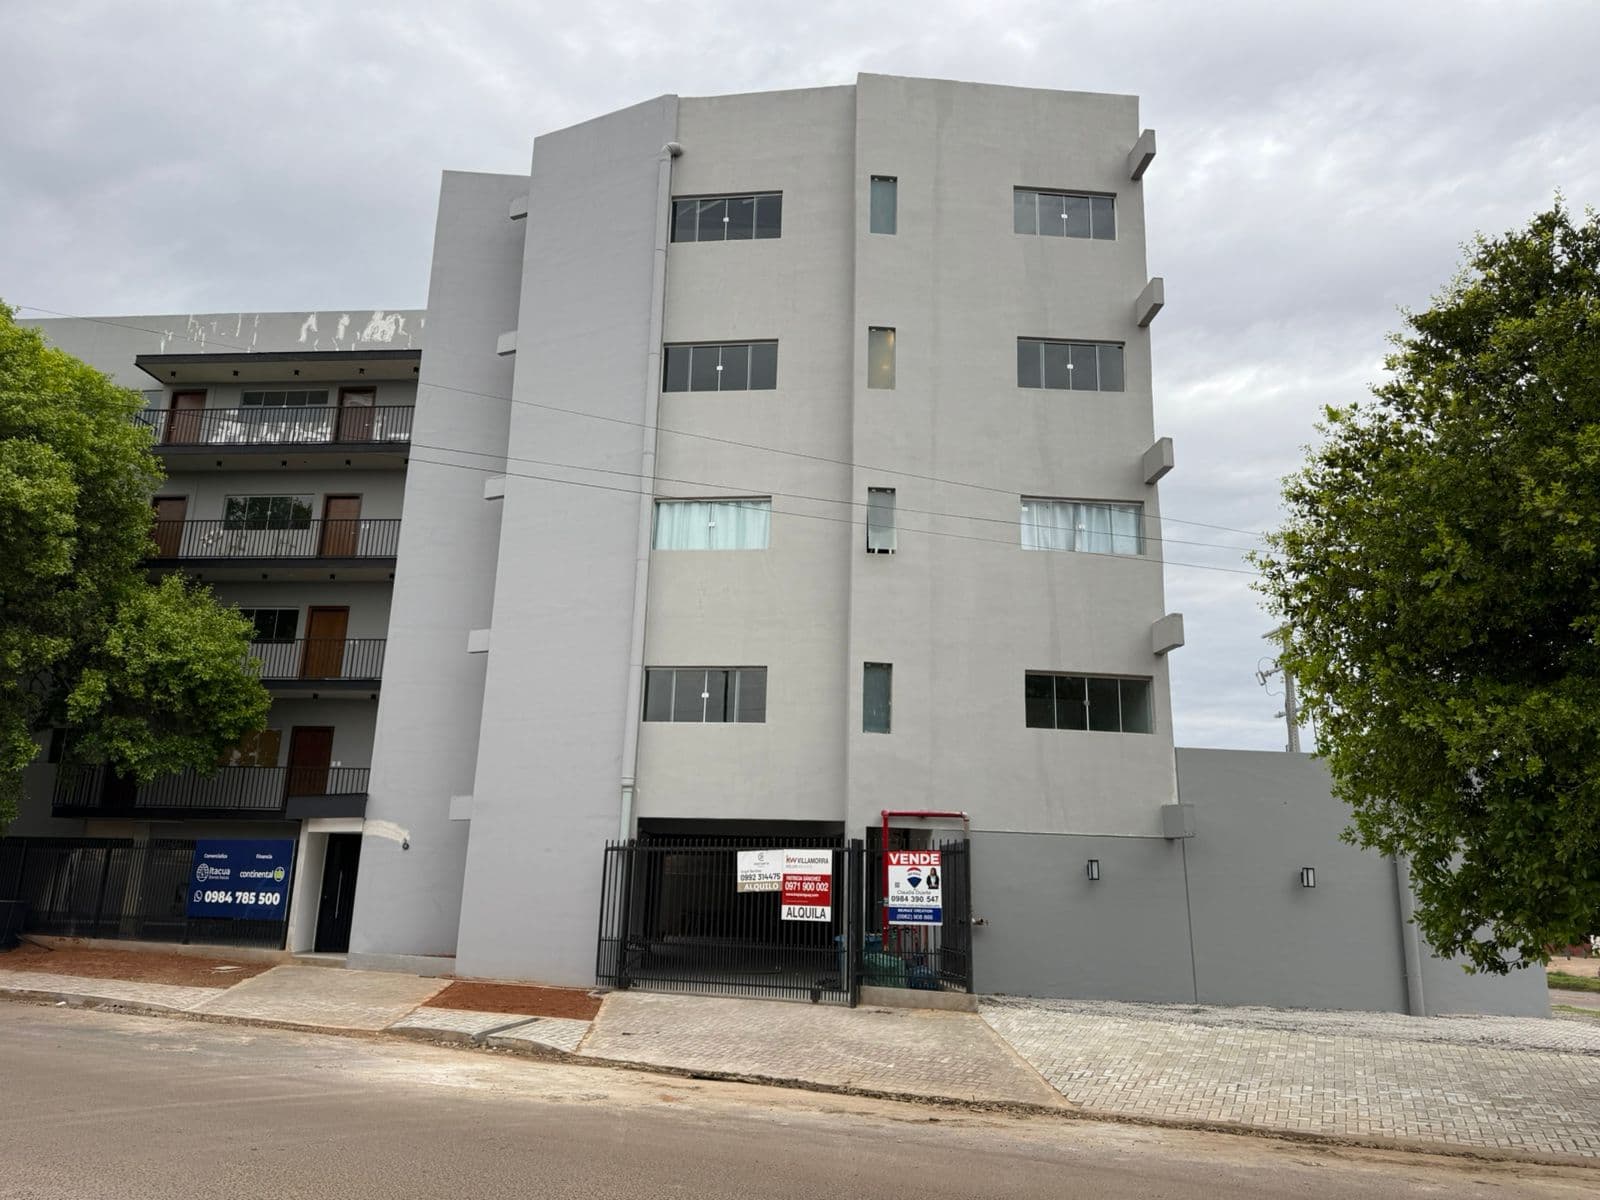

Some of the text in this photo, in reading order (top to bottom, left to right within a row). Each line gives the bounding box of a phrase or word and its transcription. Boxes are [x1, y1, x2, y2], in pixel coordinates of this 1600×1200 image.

[889, 853, 940, 865] VENDE
[240, 870, 274, 878] continental
[758, 873, 781, 881] 314475
[744, 882, 779, 890] ALQUILO
[784, 881, 829, 892] 0971 900 002
[204, 890, 280, 906] 0984 785 500
[786, 906, 826, 919] ALQUILA
